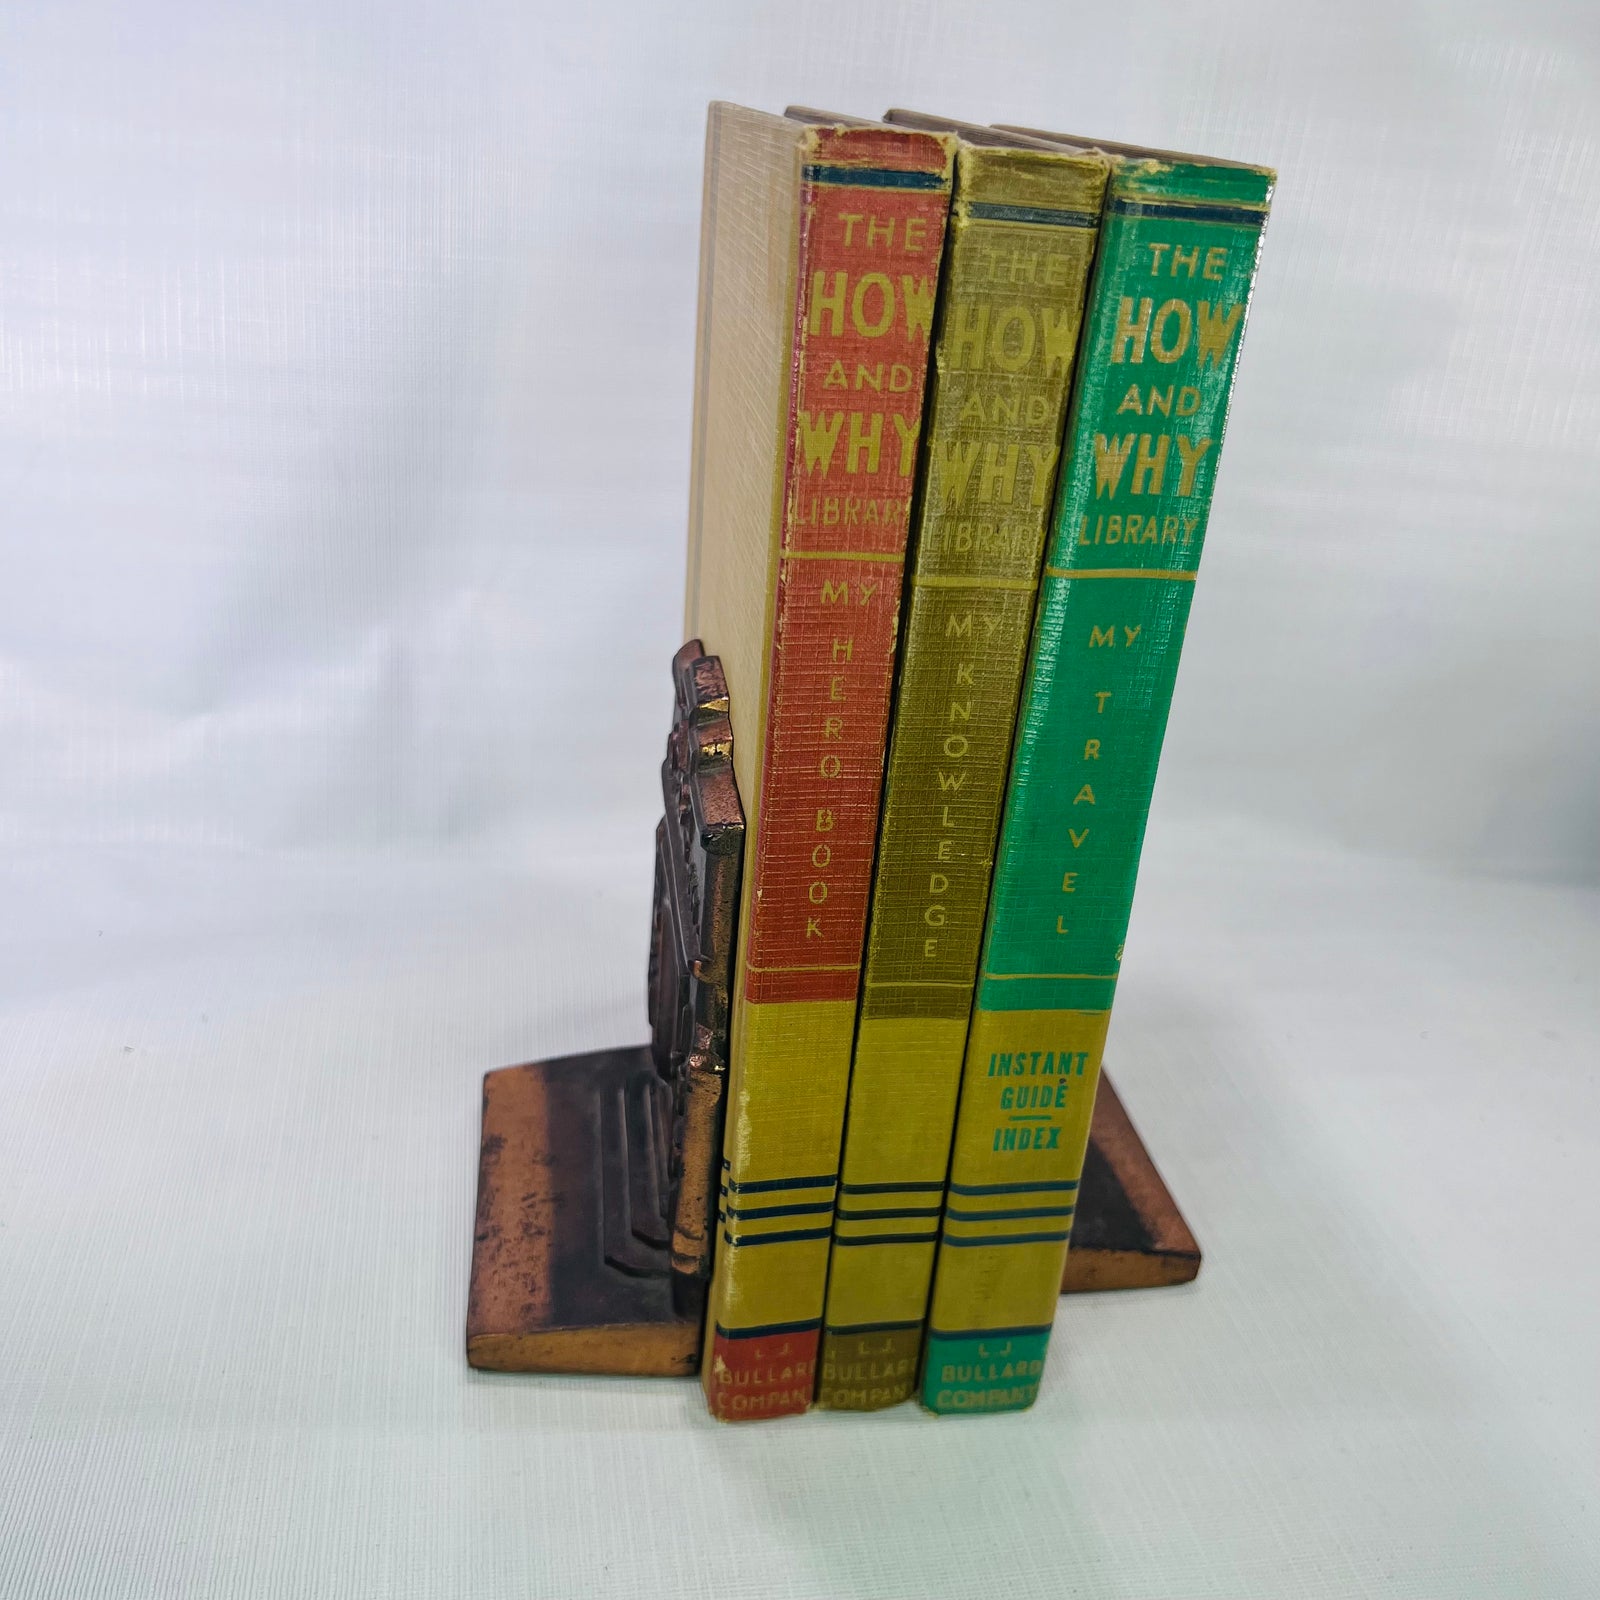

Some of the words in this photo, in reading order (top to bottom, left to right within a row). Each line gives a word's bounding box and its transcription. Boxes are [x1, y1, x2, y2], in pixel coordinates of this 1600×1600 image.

[838, 212, 927, 251] THE
[985, 250, 1073, 286] THE
[1148, 242, 1228, 282] THE
[809, 270, 936, 344] HOW
[952, 303, 1082, 377] HOW
[1110, 297, 1244, 371] HOW
[822, 359, 913, 393] AND
[960, 391, 1050, 426] AND
[1116, 383, 1202, 418] AND
[798, 410, 922, 479] WHY
[936, 440, 1061, 506] WHY
[1094, 432, 1214, 500] WHY
[1078, 514, 1200, 546] LIBRARY
[820, 580, 878, 606] MY
[945, 613, 1003, 637] MY
[1088, 624, 1142, 649] MY
[819, 636, 854, 780] HERO
[923, 662, 975, 959] KNOWLEDGE
[1056, 690, 1112, 935] TRAVEL
[806, 808, 834, 940] BOOK
[988, 1052, 1089, 1077] INSTANT
[1000, 1085, 1069, 1110] GUIDE
[993, 1126, 1062, 1152] INDEX
